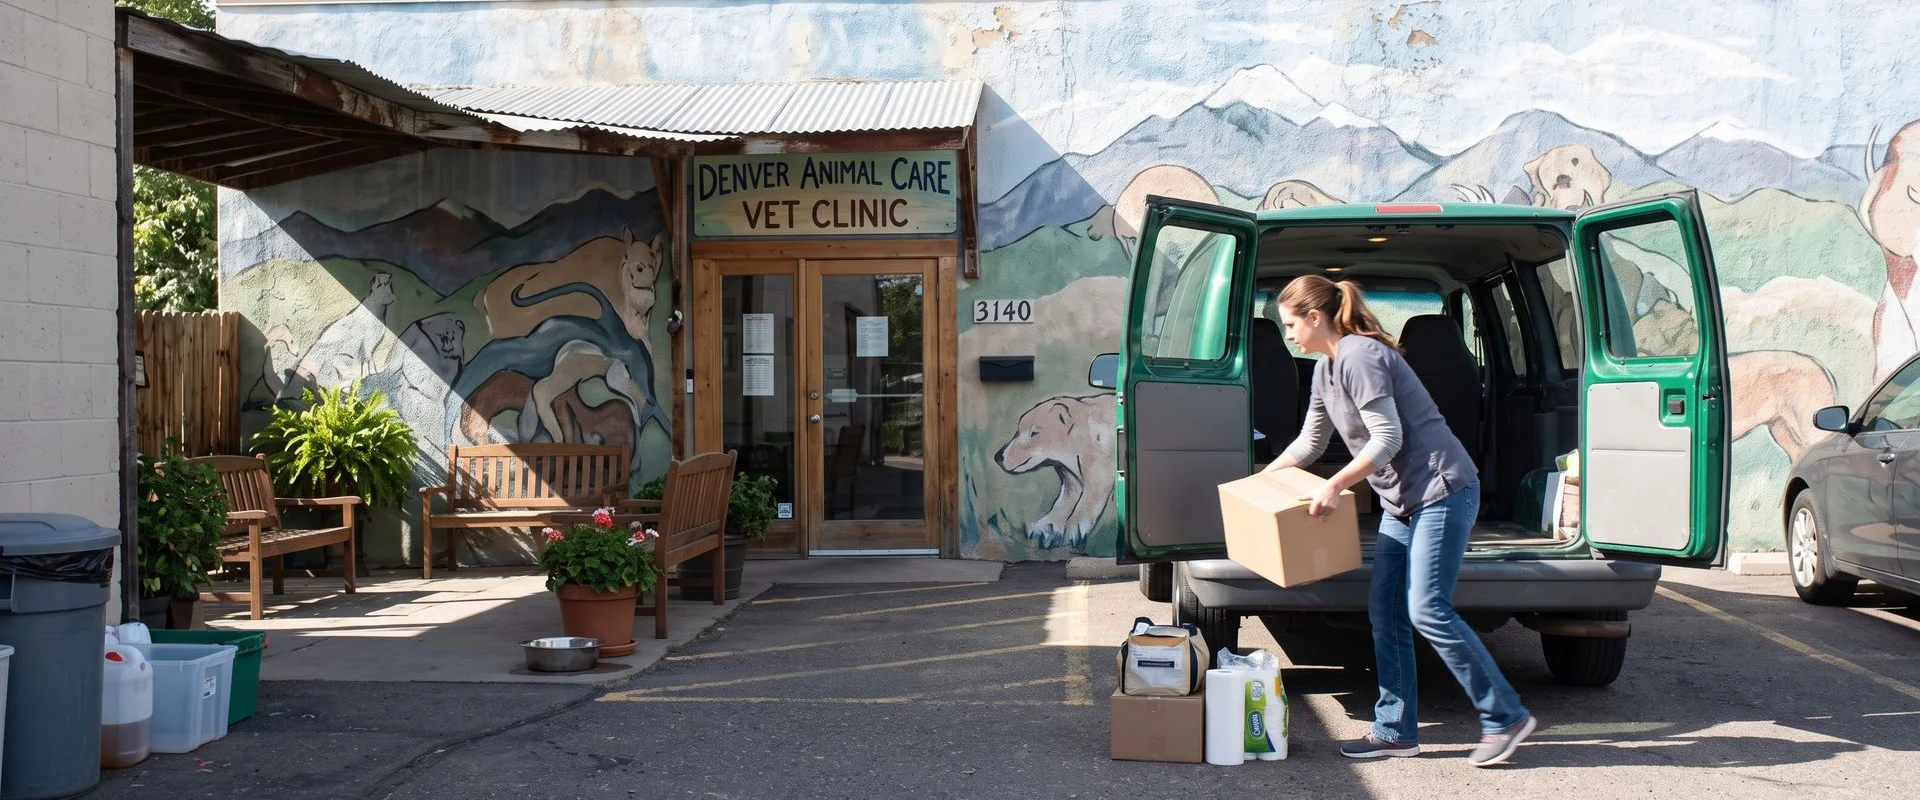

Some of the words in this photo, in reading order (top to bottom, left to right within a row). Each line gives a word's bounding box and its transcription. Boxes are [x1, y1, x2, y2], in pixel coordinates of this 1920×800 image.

[699, 162, 790, 201] DENVER
[800, 156, 882, 189] ANIMAL
[890, 157, 951, 195] CARE
[742, 200, 800, 229] VET
[812, 199, 909, 229] CLINIC
[975, 300, 1031, 322] 3140
